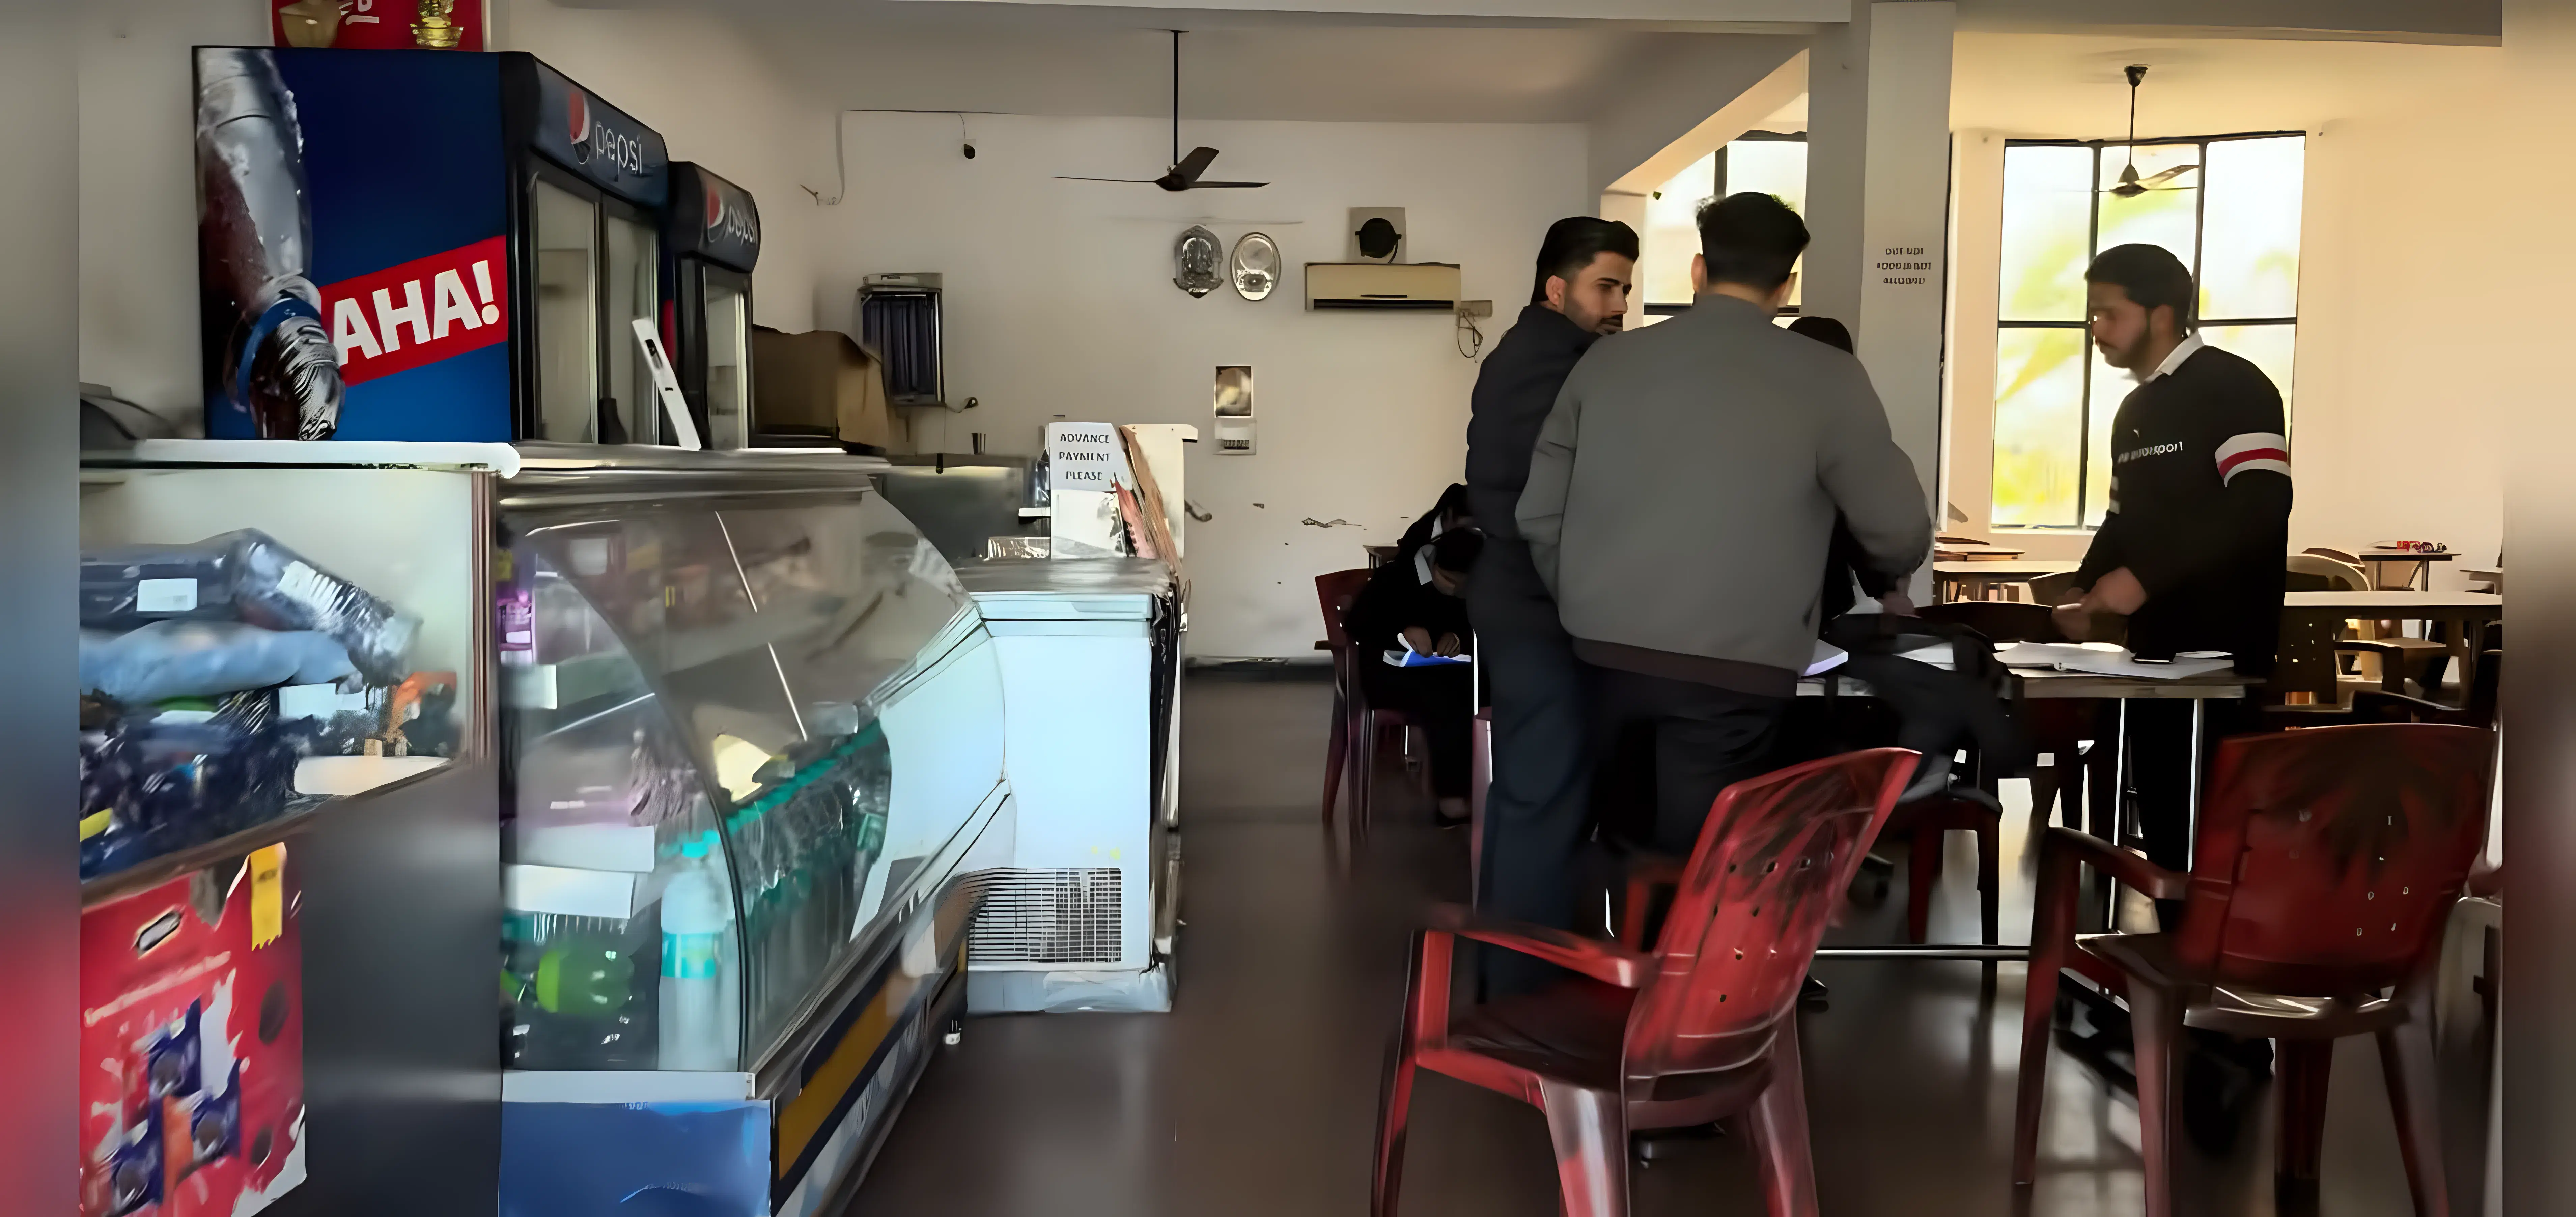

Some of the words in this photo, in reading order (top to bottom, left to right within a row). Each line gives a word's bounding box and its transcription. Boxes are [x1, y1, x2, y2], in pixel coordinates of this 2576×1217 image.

[595, 120, 642, 175] pepsi
[333, 260, 500, 367] AHA!
[1060, 433, 1110, 443] ADVANCE
[1066, 471, 1102, 480] PLEASE
